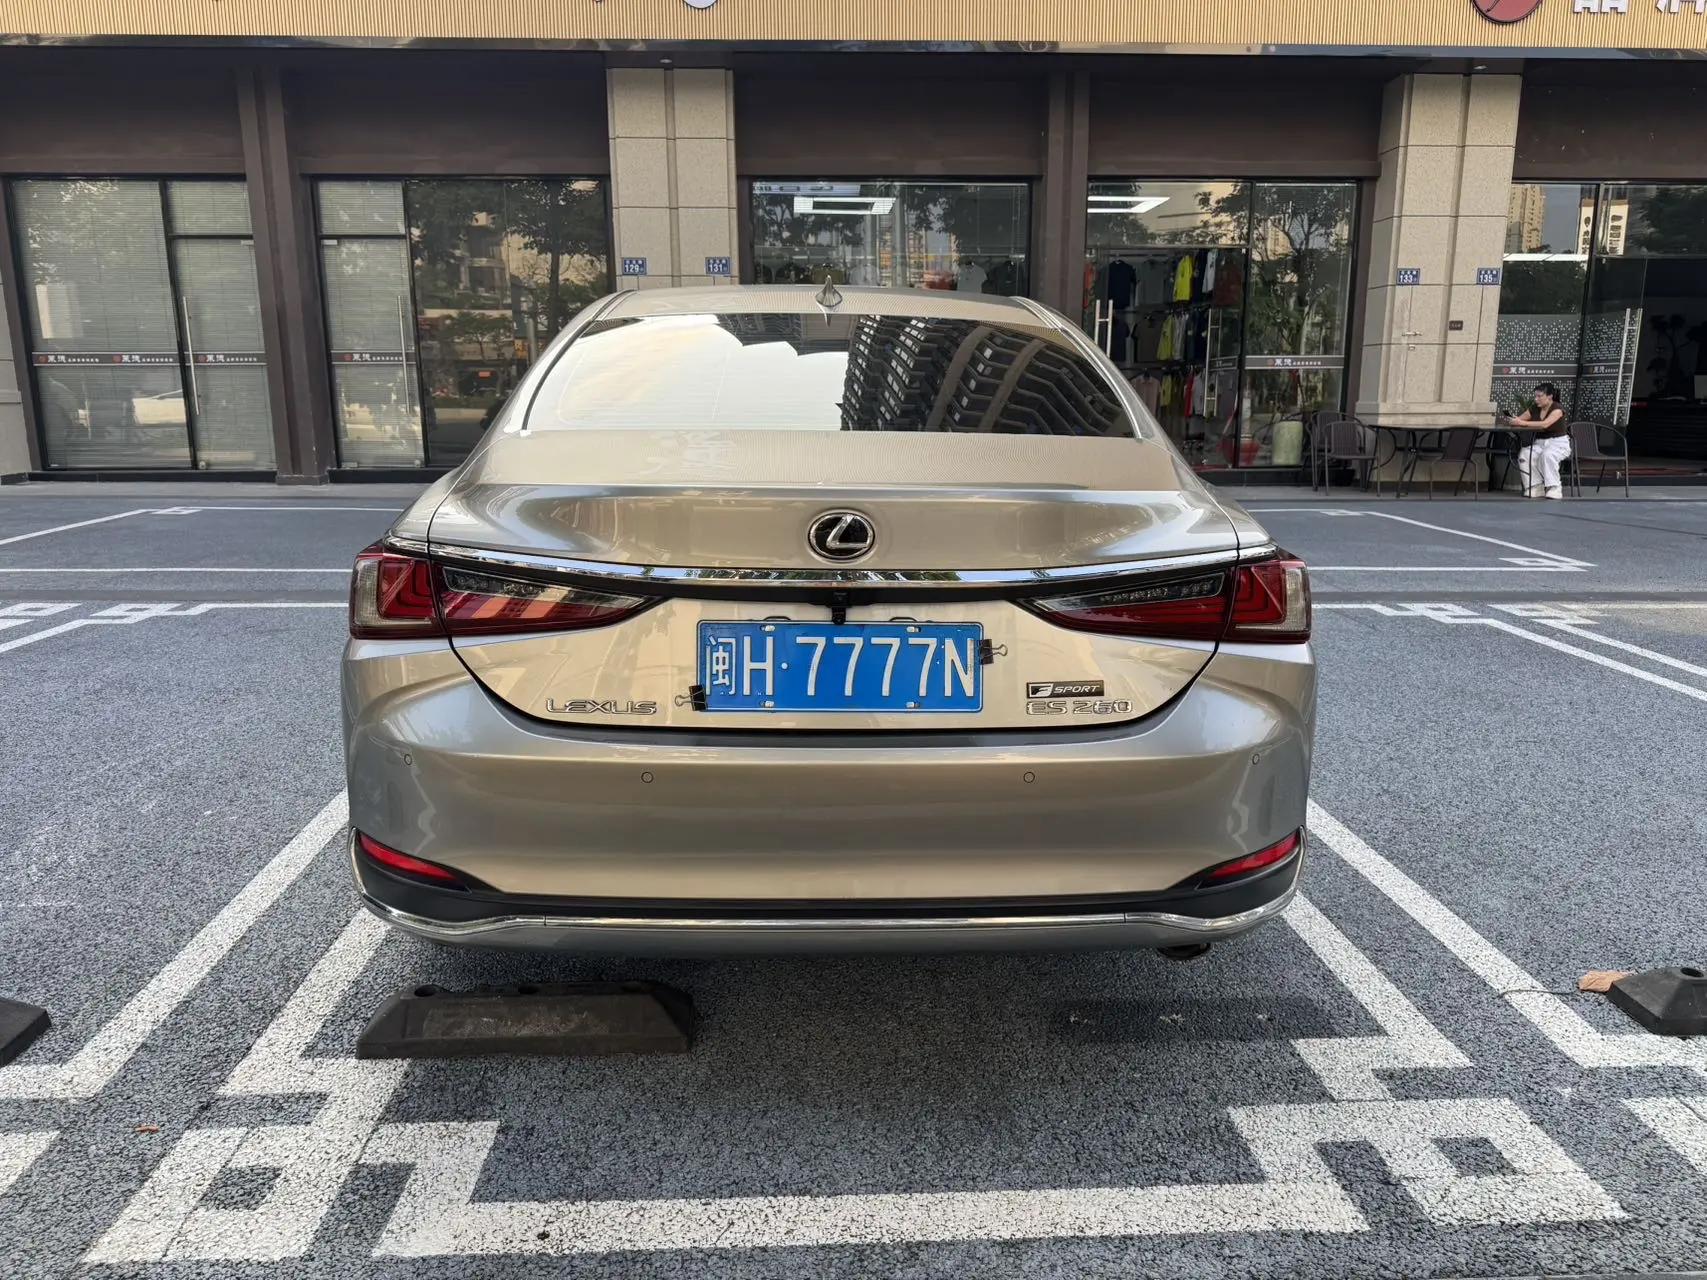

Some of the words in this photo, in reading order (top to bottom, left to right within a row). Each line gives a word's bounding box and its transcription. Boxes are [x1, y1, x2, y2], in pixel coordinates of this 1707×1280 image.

[1053, 685, 1100, 694] SPORT
[546, 699, 657, 715] LEXUS
[1026, 701, 1067, 715] ES
[1073, 700, 1133, 715] 260
